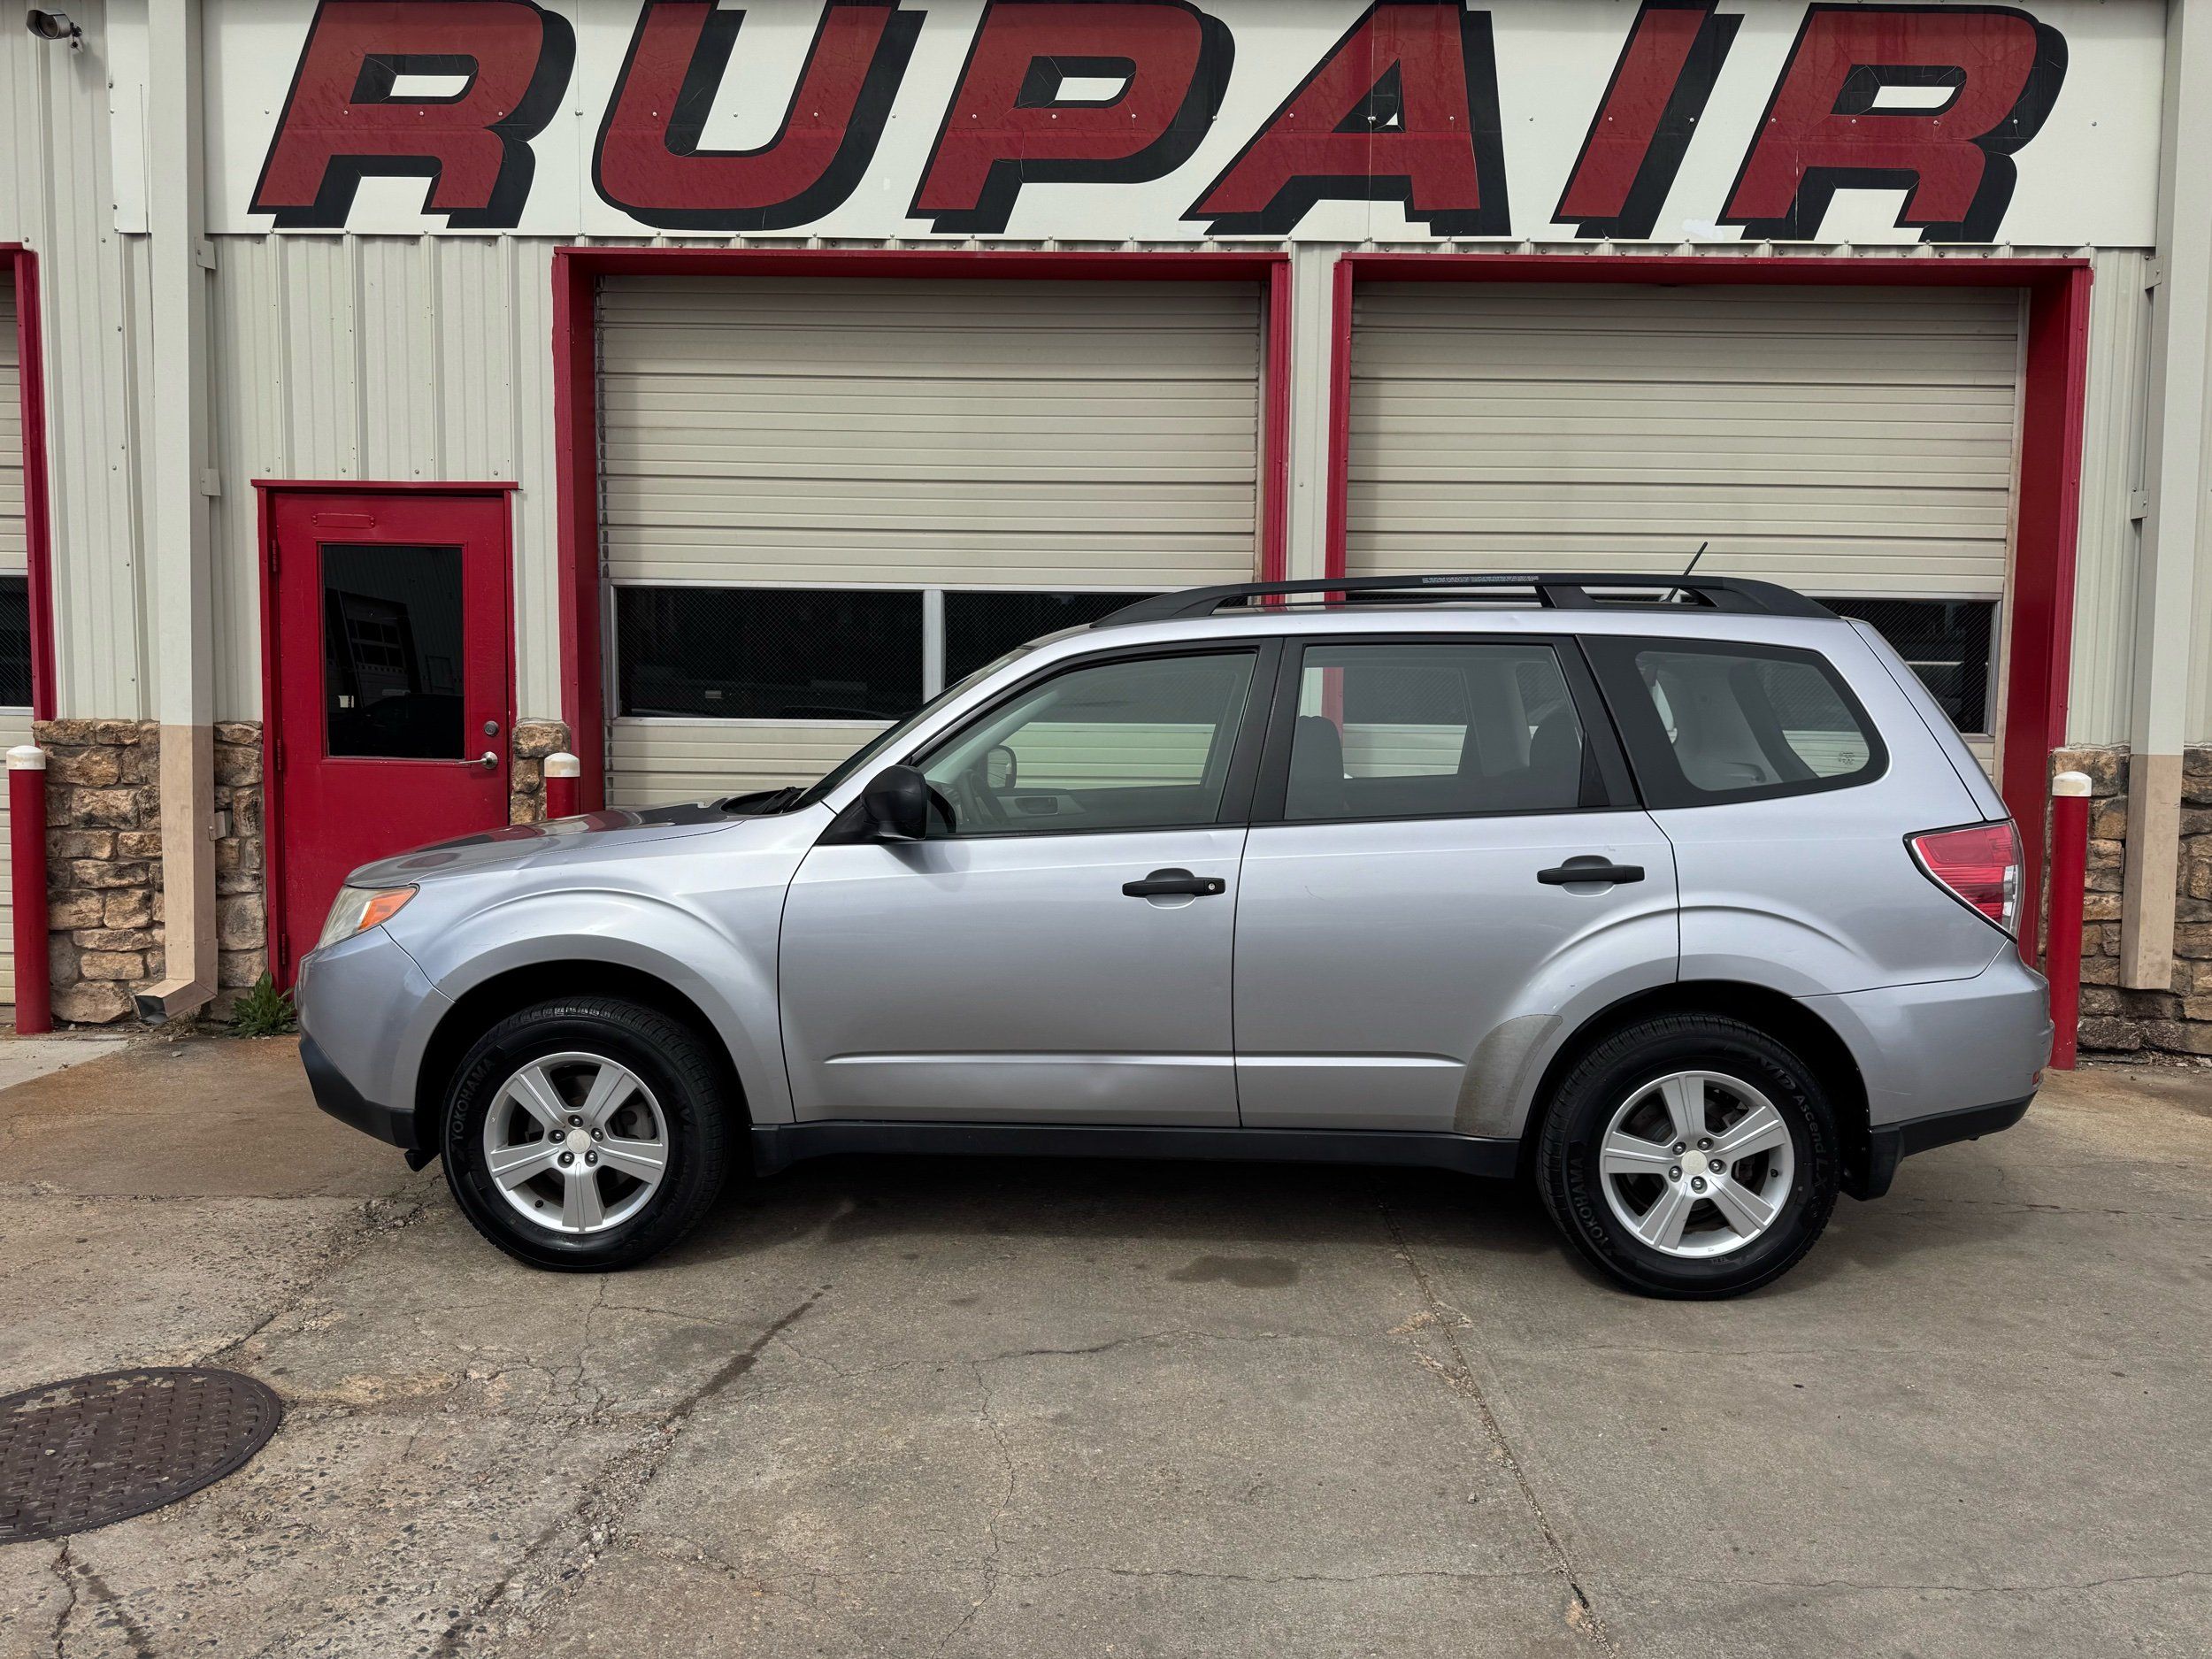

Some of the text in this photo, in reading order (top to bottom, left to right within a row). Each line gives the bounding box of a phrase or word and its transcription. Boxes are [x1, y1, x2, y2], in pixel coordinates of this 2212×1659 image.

[248, 0, 2069, 242] RUPAIR
[450, 1057, 495, 1141] YOKOHAMA
[1792, 1094, 1826, 1154] Ascend
[1569, 1156, 1610, 1248] YOKOHAMA
